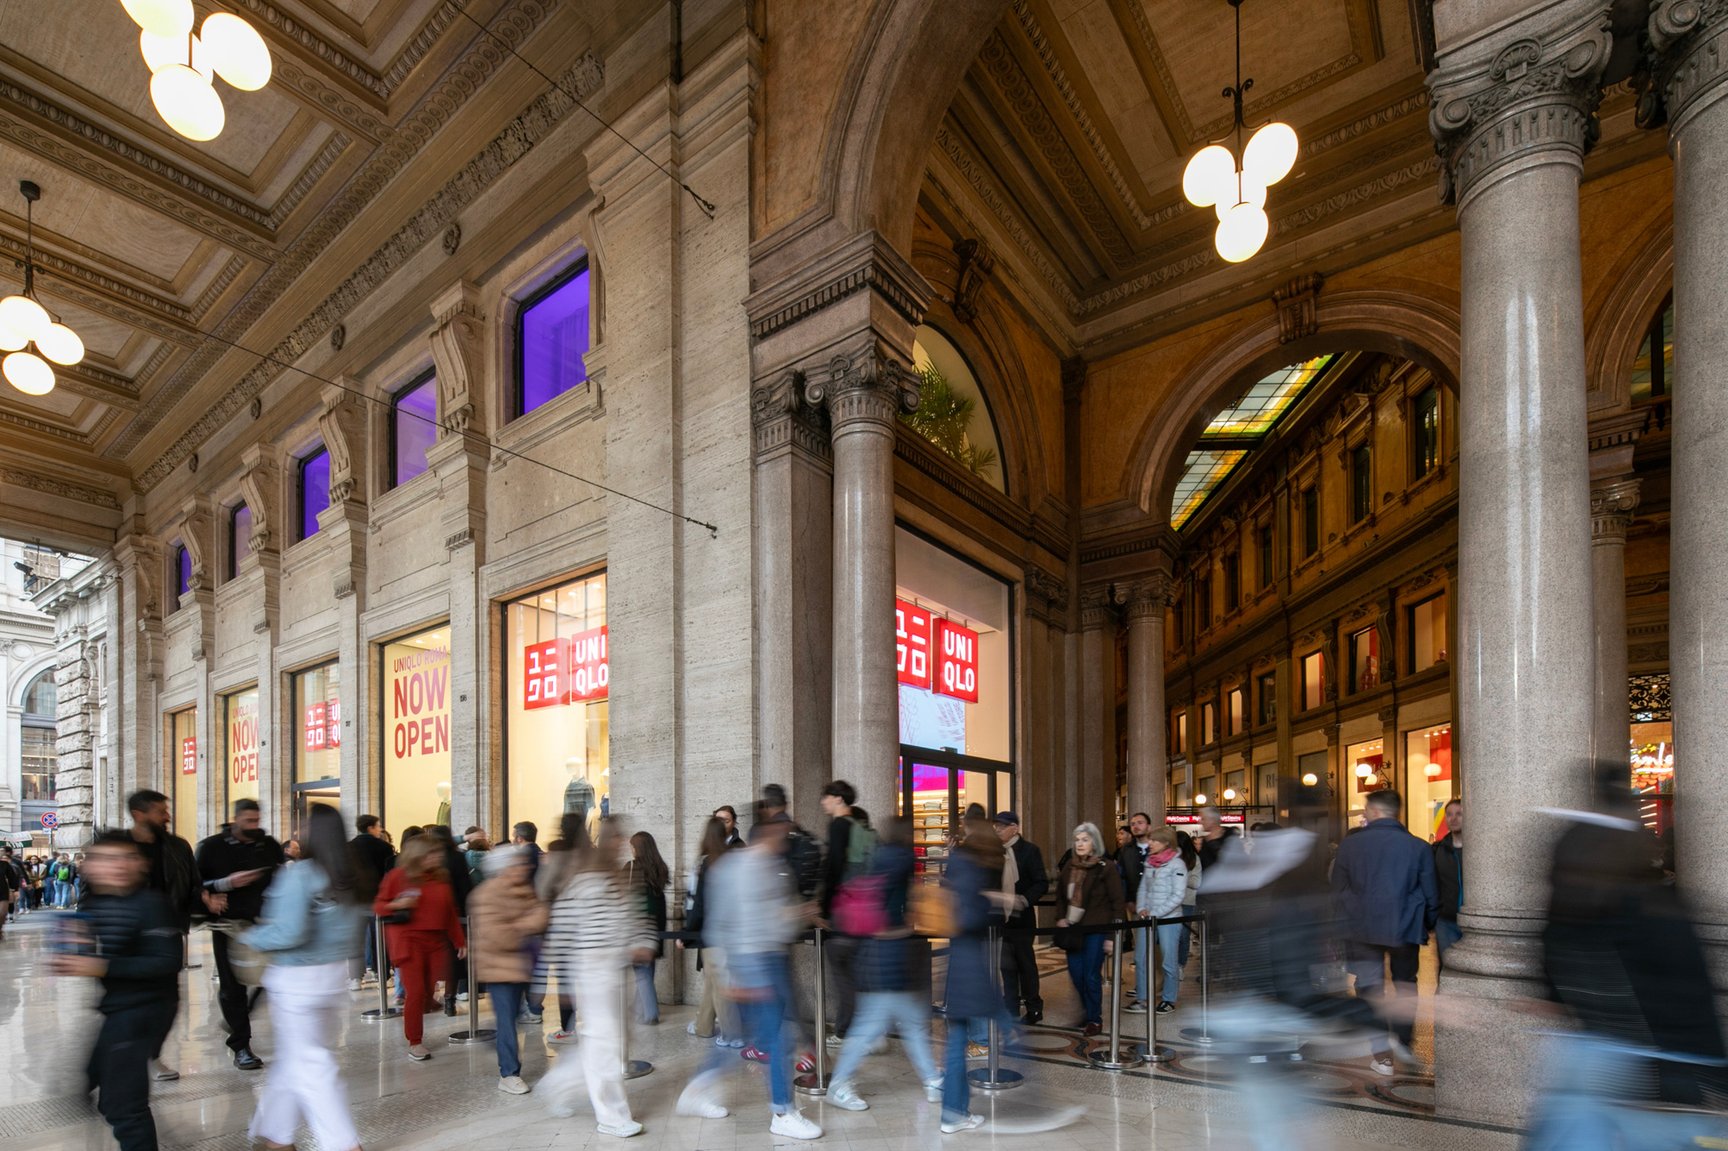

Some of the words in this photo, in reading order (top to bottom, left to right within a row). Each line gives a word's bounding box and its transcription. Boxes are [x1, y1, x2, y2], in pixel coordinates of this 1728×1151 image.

[394, 652, 422, 673] UNIQLO
[424, 646, 448, 664] ROMA
[528, 647, 557, 675] ユニ
[576, 634, 606, 664] UNI
[944, 629, 972, 663] UNI
[394, 665, 448, 719] NOW
[527, 675, 557, 702] クロ
[576, 663, 609, 696] QLO
[944, 661, 975, 692] QLO
[395, 714, 448, 759] OPEN
